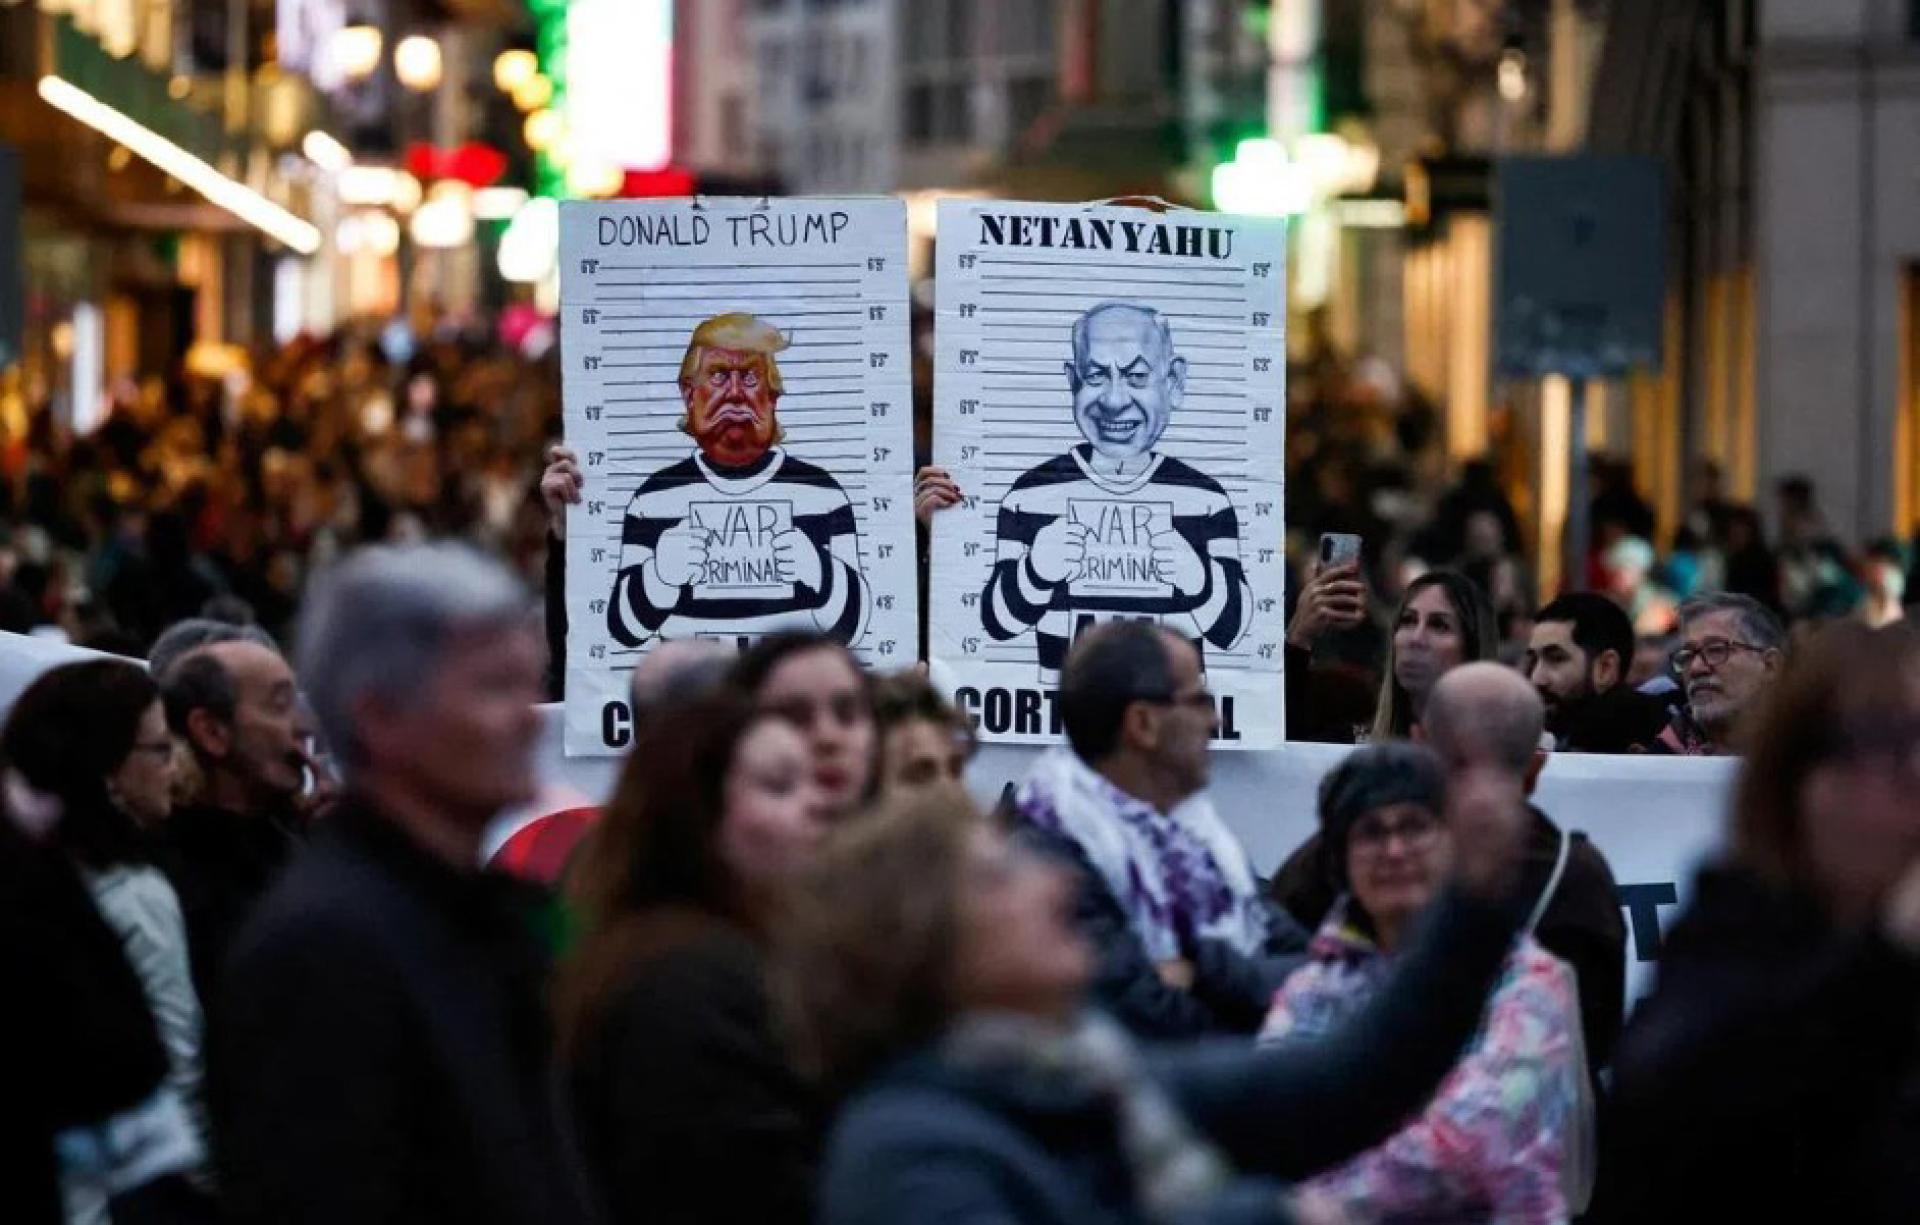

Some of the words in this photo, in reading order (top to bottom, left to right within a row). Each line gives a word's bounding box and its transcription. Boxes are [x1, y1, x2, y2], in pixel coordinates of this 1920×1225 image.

[599, 215, 710, 246] DONALD
[726, 212, 849, 247] TRUMP
[979, 214, 1235, 260] NETANYAHU
